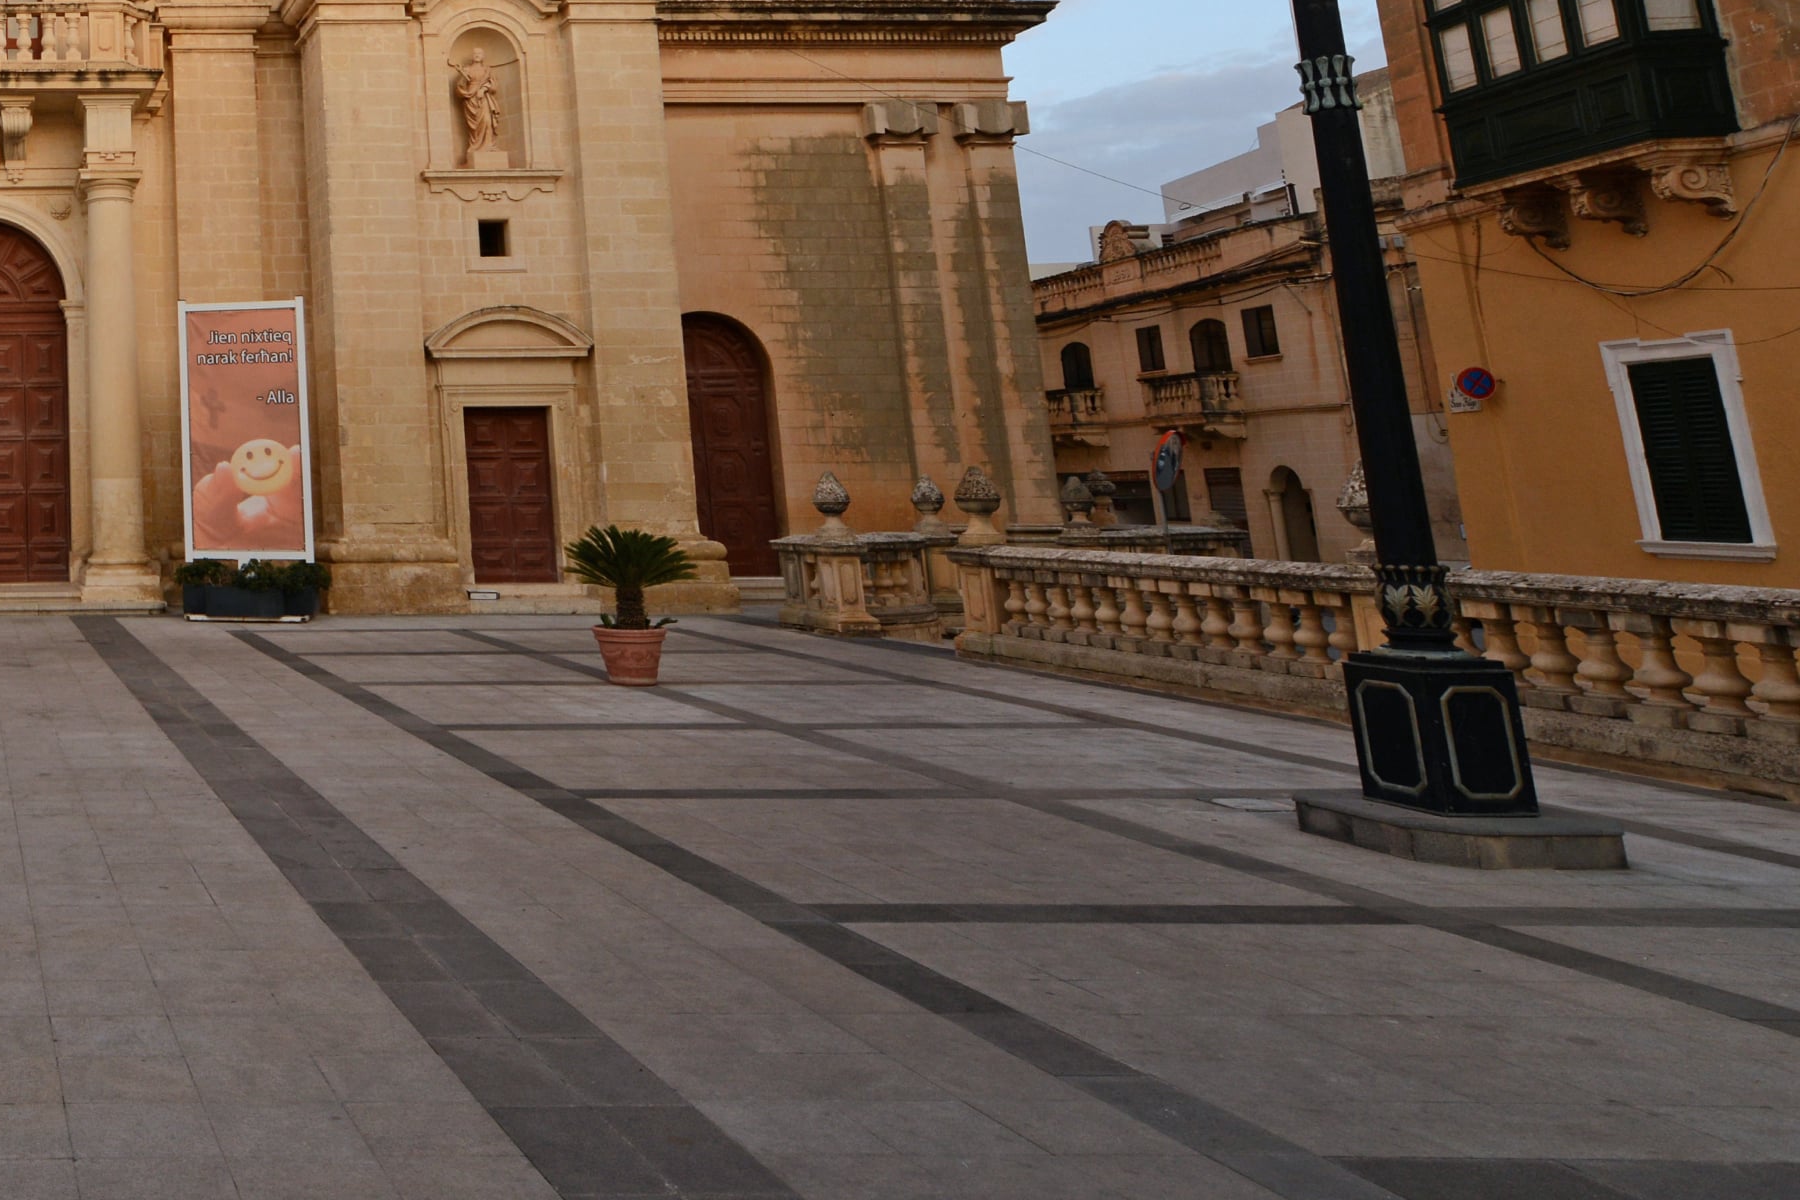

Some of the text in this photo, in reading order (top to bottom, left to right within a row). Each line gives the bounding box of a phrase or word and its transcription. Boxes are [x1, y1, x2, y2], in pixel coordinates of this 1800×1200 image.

[208, 328, 292, 345] Jien nixtieq
[197, 348, 293, 365] narak ferħan!
[266, 389, 295, 404] Alla
